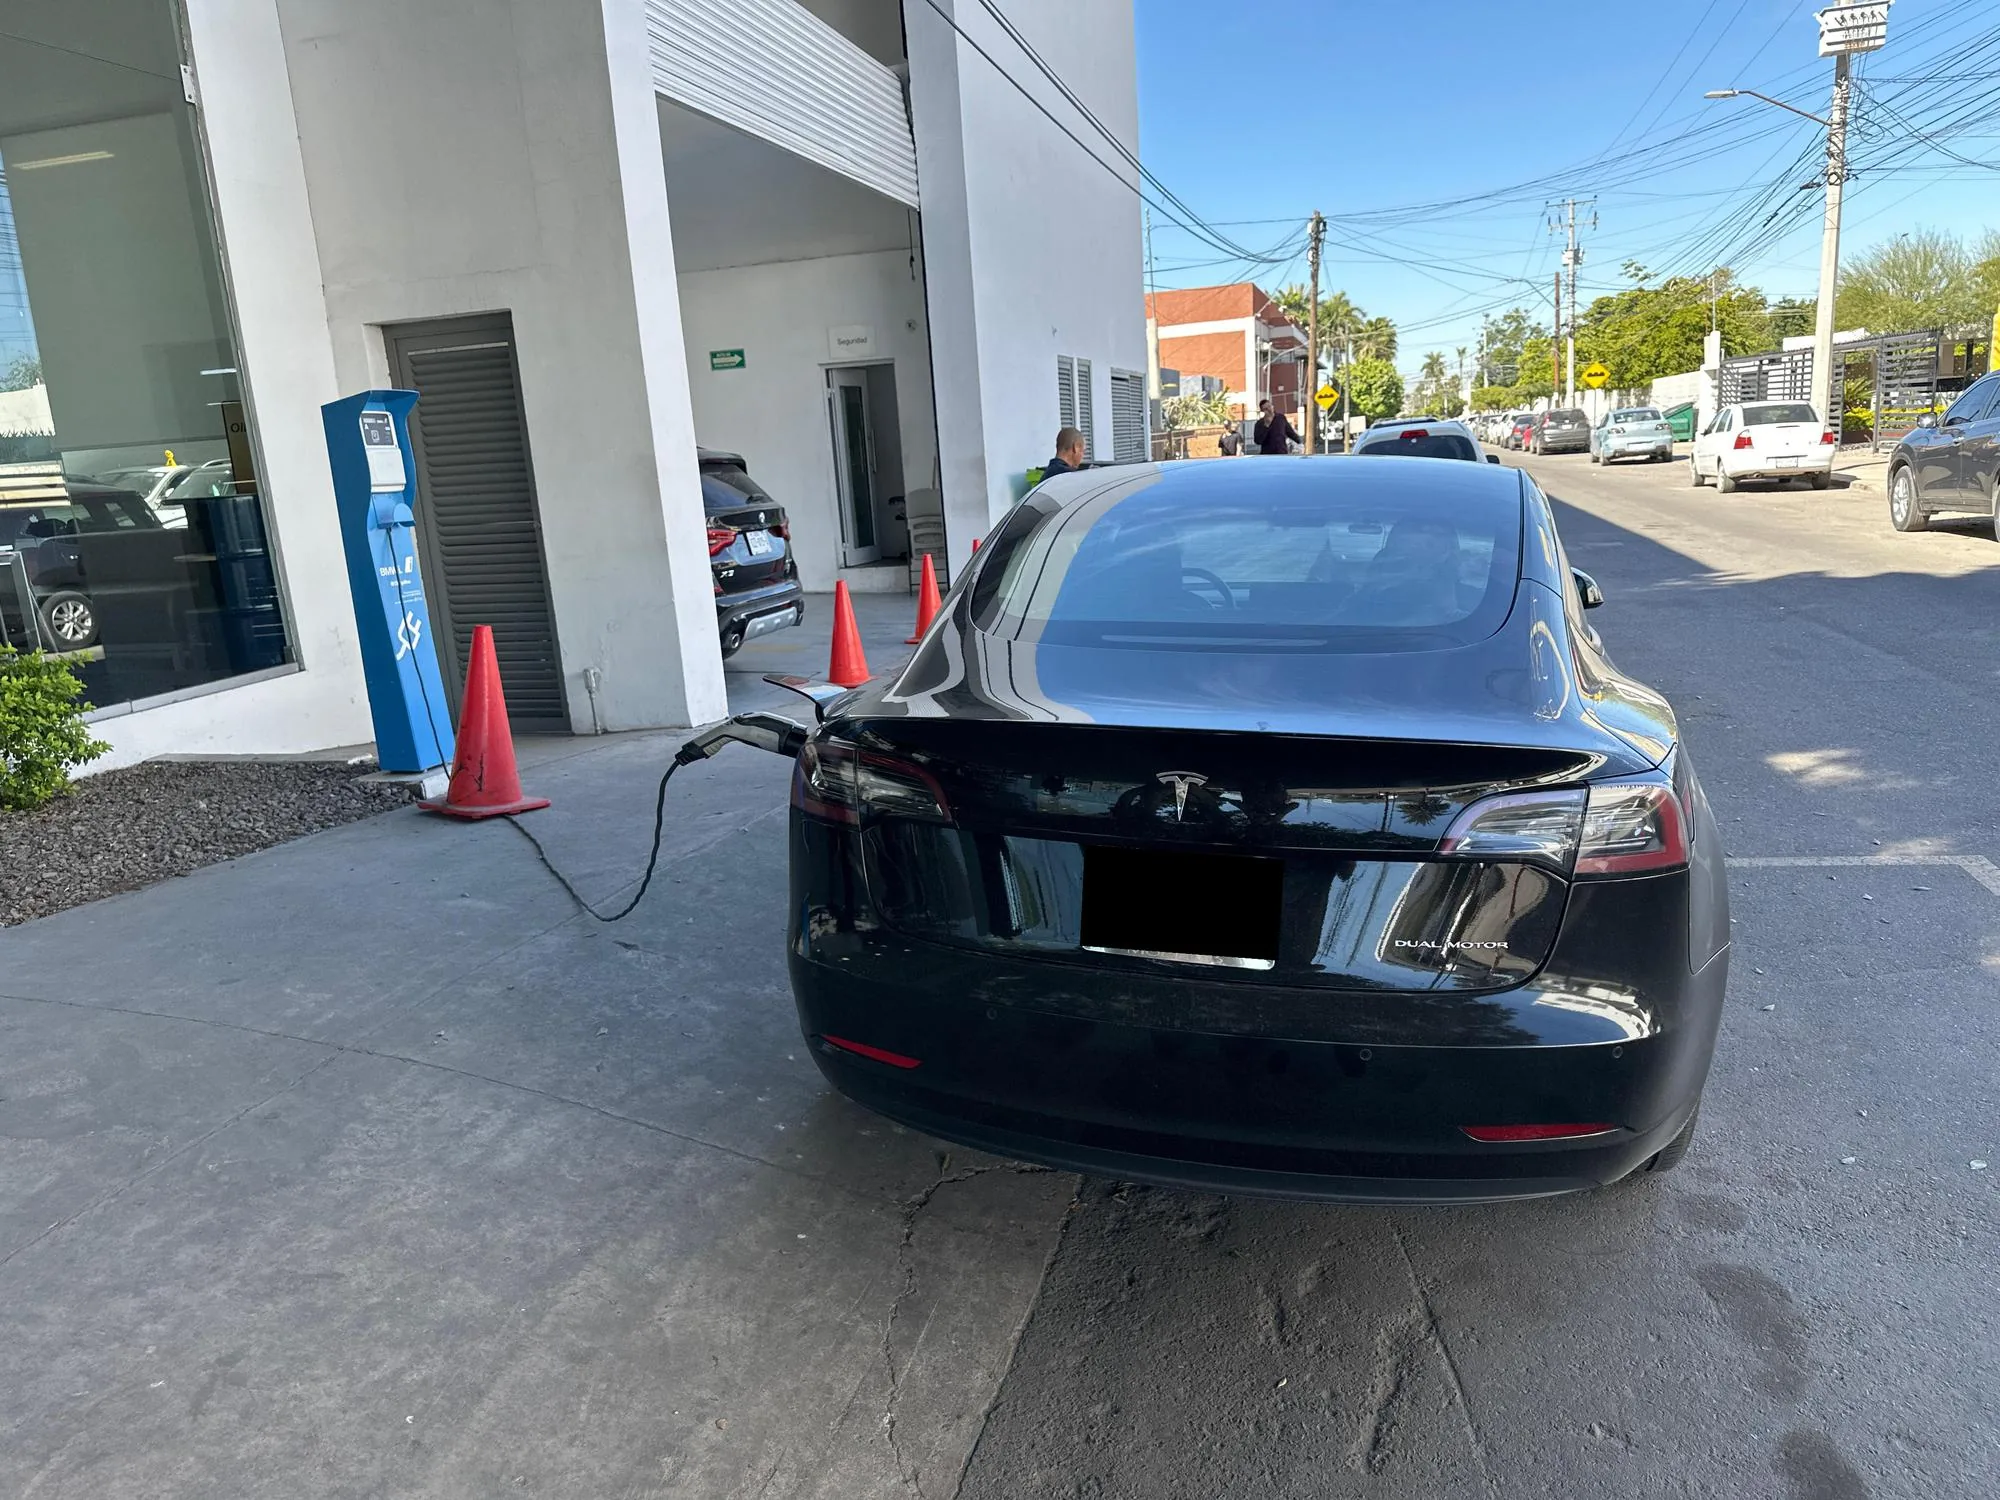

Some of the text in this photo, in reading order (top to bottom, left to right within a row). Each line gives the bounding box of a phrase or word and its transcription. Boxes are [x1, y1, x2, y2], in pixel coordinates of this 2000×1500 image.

[837, 336, 867, 346] Seguridad
[720, 569, 735, 578] X3
[1394, 940, 1508, 949] DUAL MOTOR
